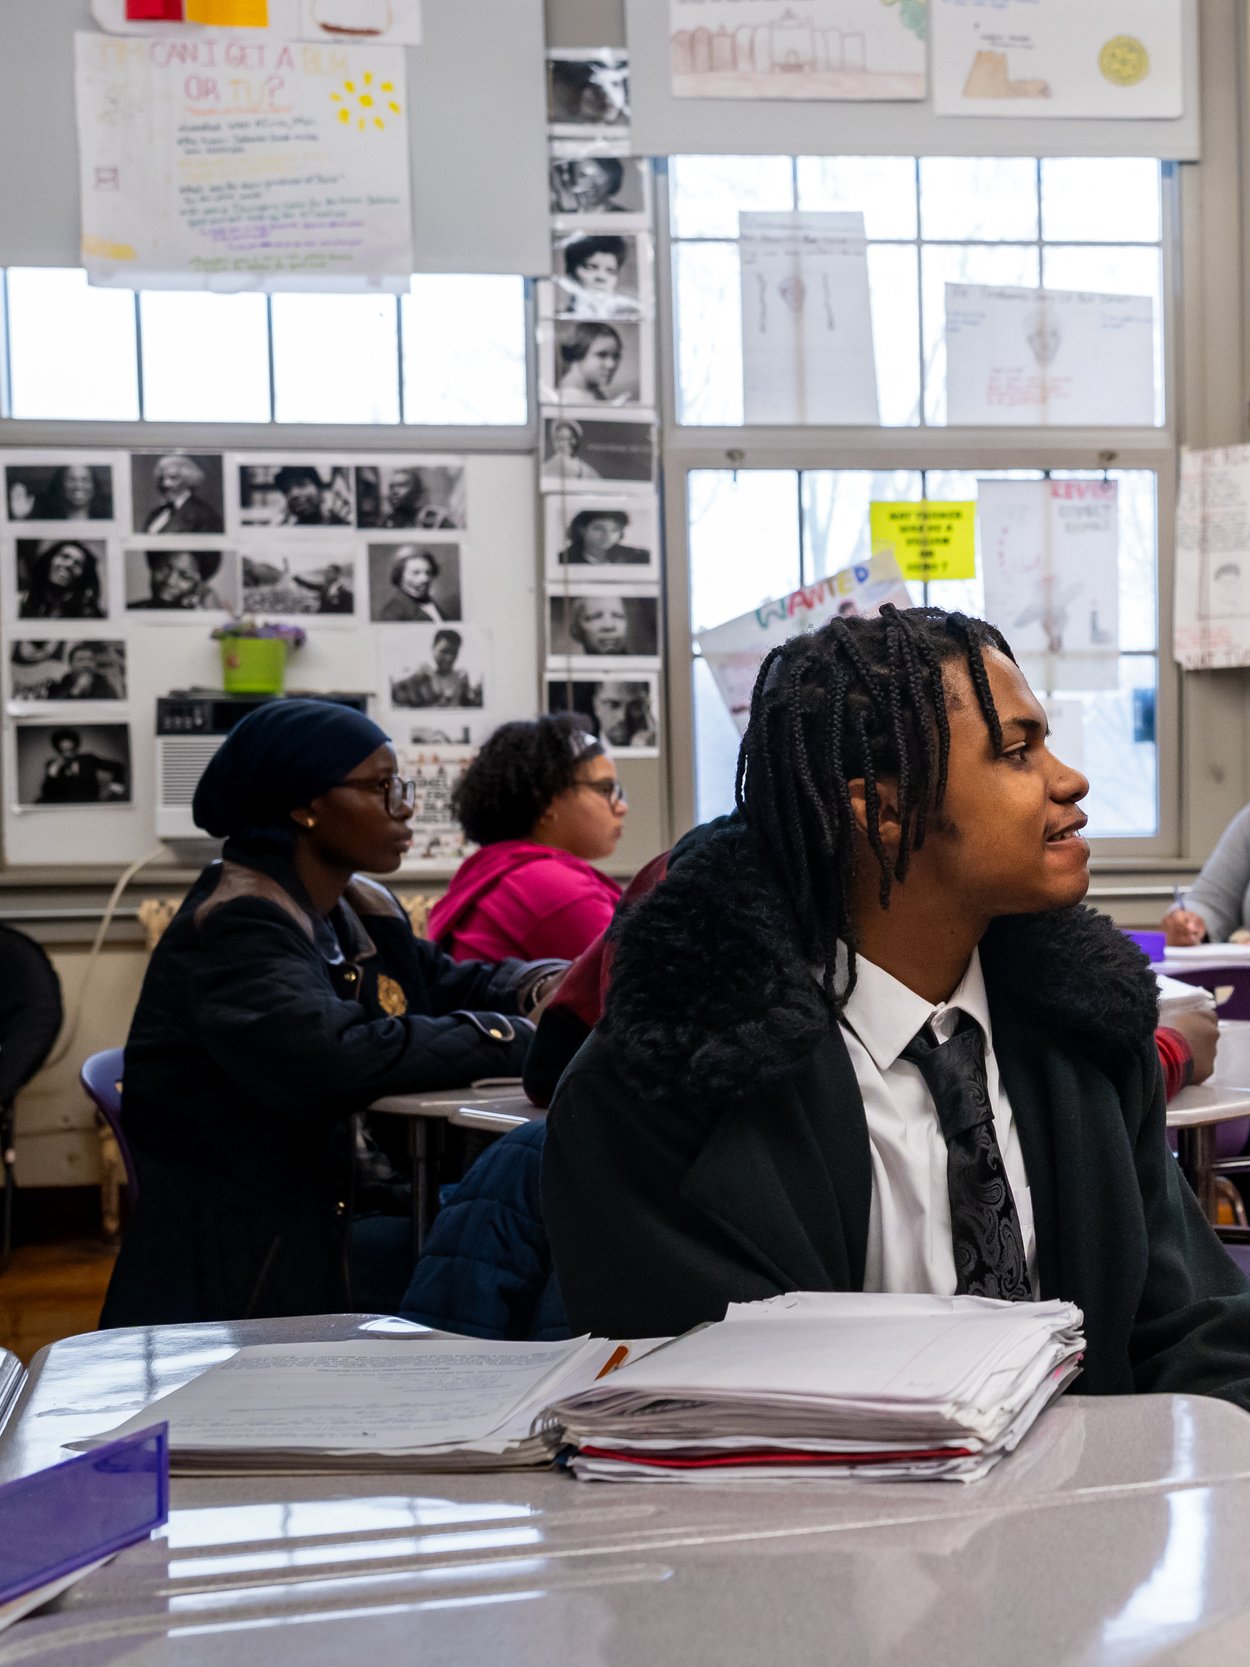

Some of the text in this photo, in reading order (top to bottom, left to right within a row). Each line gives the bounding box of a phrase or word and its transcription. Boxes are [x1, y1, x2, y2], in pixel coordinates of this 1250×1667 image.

[150, 39, 198, 69] CAN
[202, 38, 218, 68] I
[276, 46, 296, 71] A
[183, 72, 222, 103] OR
[754, 566, 870, 629] WANTED
